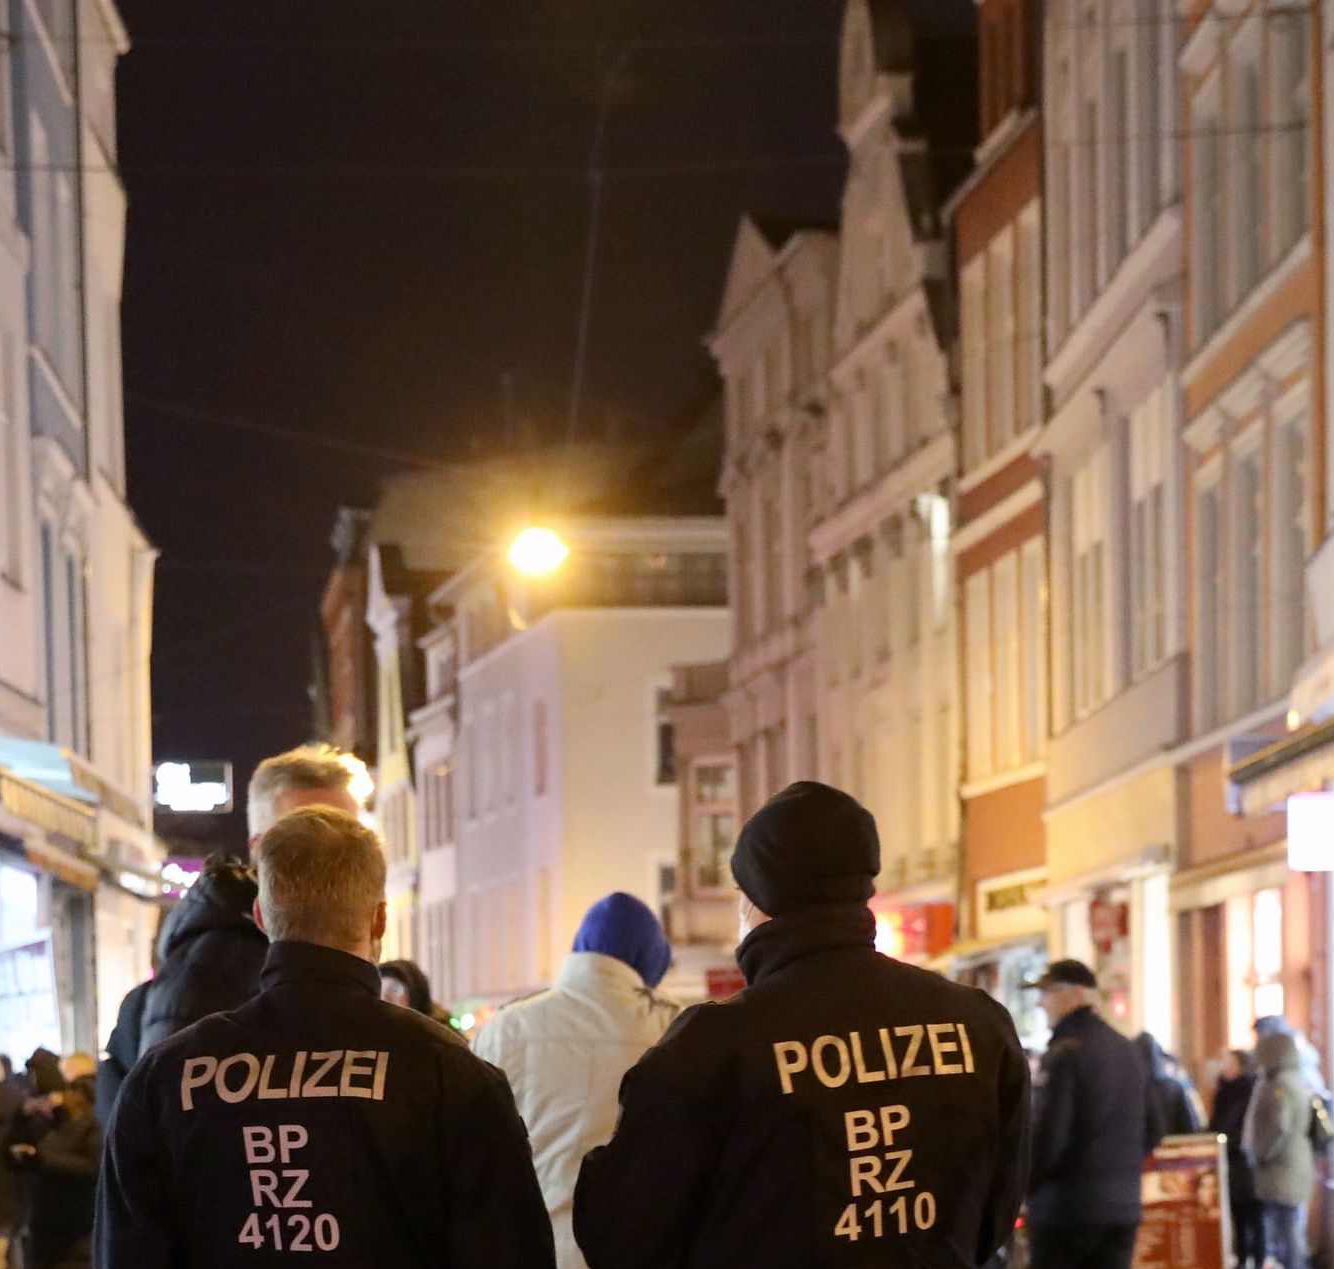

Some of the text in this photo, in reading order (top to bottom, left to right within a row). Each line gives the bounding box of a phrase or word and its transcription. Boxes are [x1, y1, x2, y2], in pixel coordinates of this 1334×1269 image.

[180, 1049, 390, 1112] POLIZEI
[773, 1023, 975, 1095] POLIZEI
[242, 1124, 309, 1164] BP
[844, 1104, 912, 1152] BP
[249, 1169, 314, 1208] RZ
[849, 1149, 916, 1197] RZ
[238, 1213, 341, 1252] 4120
[833, 1191, 937, 1242] 4110
